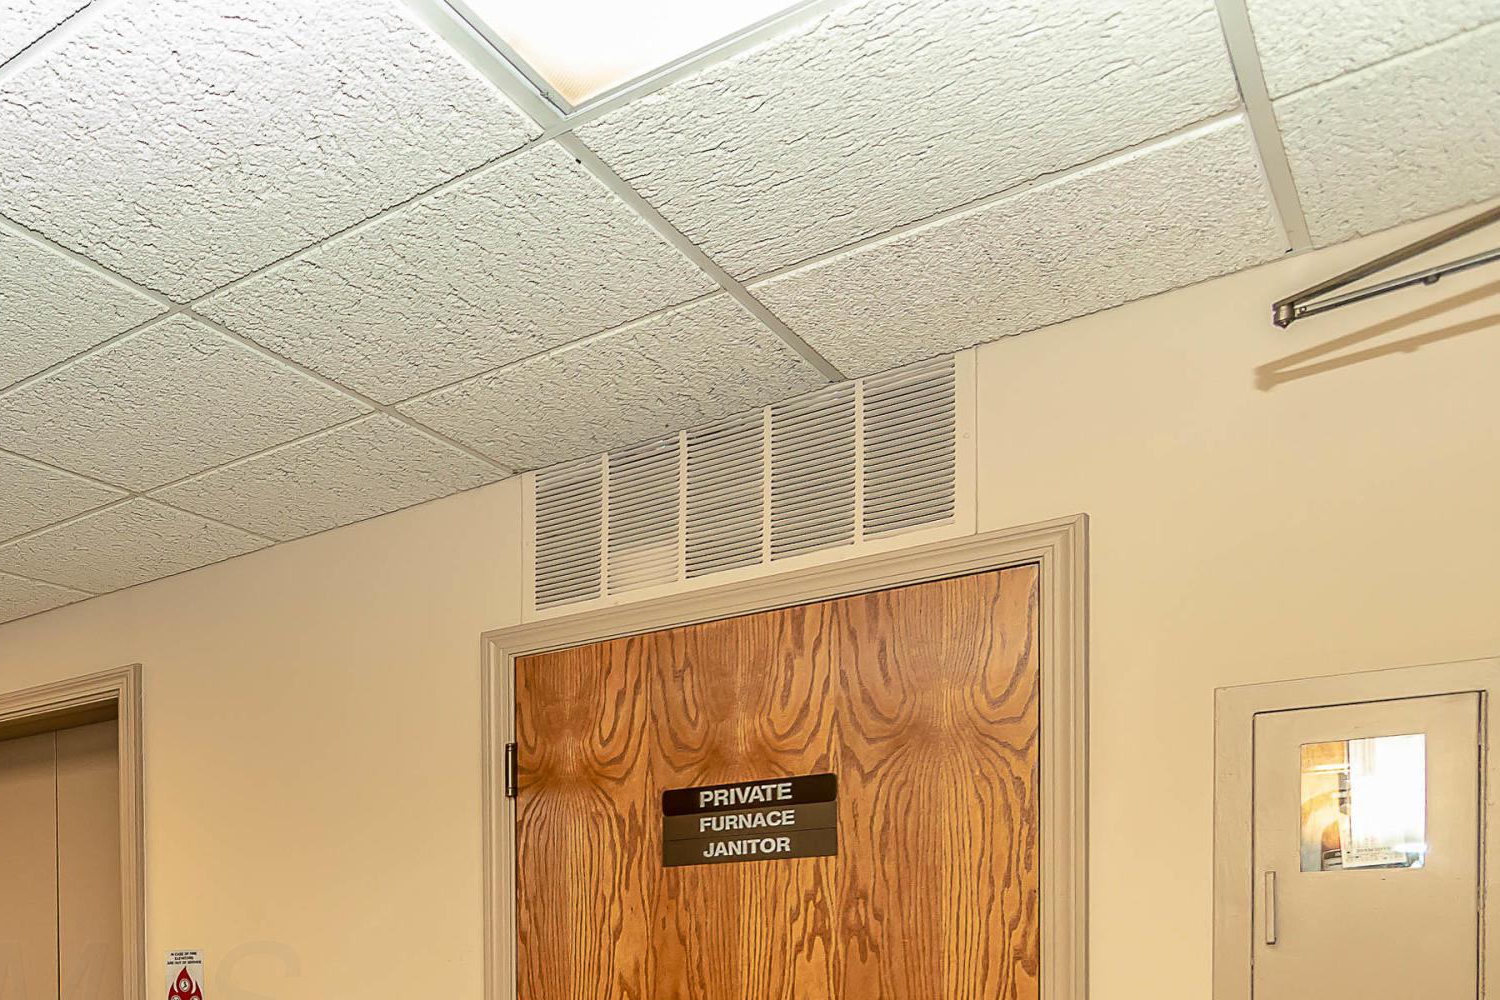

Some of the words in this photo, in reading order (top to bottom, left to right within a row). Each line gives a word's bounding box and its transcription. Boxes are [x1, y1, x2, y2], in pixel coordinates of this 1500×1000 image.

[699, 782, 793, 808] PRIVATE
[699, 809, 796, 833] FURNACE
[703, 837, 791, 858] JANITOR
